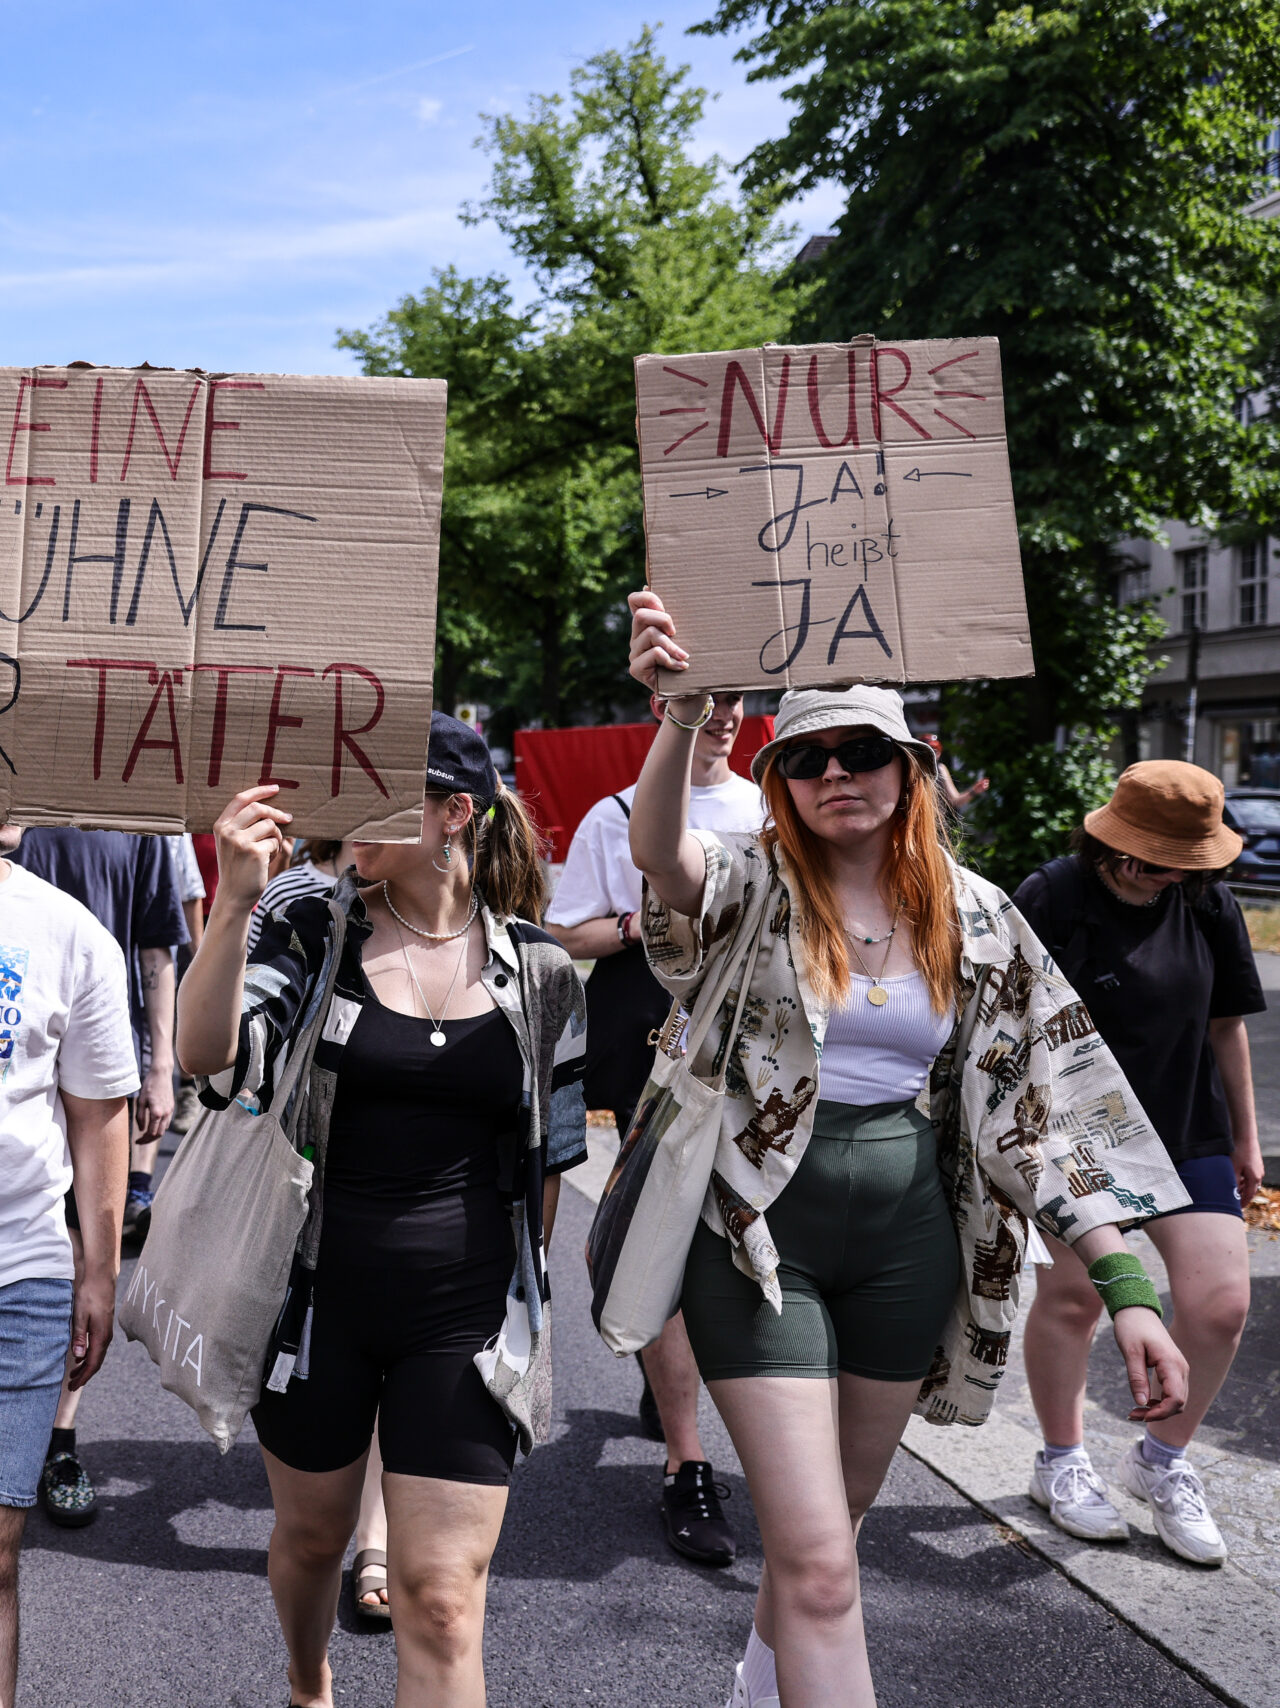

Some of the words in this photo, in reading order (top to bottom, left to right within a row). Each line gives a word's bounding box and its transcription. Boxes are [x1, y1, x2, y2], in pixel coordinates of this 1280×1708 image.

[716, 348, 932, 457] NUR
[739, 450, 887, 552] JA!
[806, 518, 902, 582] heißt
[751, 578, 894, 675] JA
[67, 658, 391, 800] TÄTER
[427, 768, 455, 781] subsun
